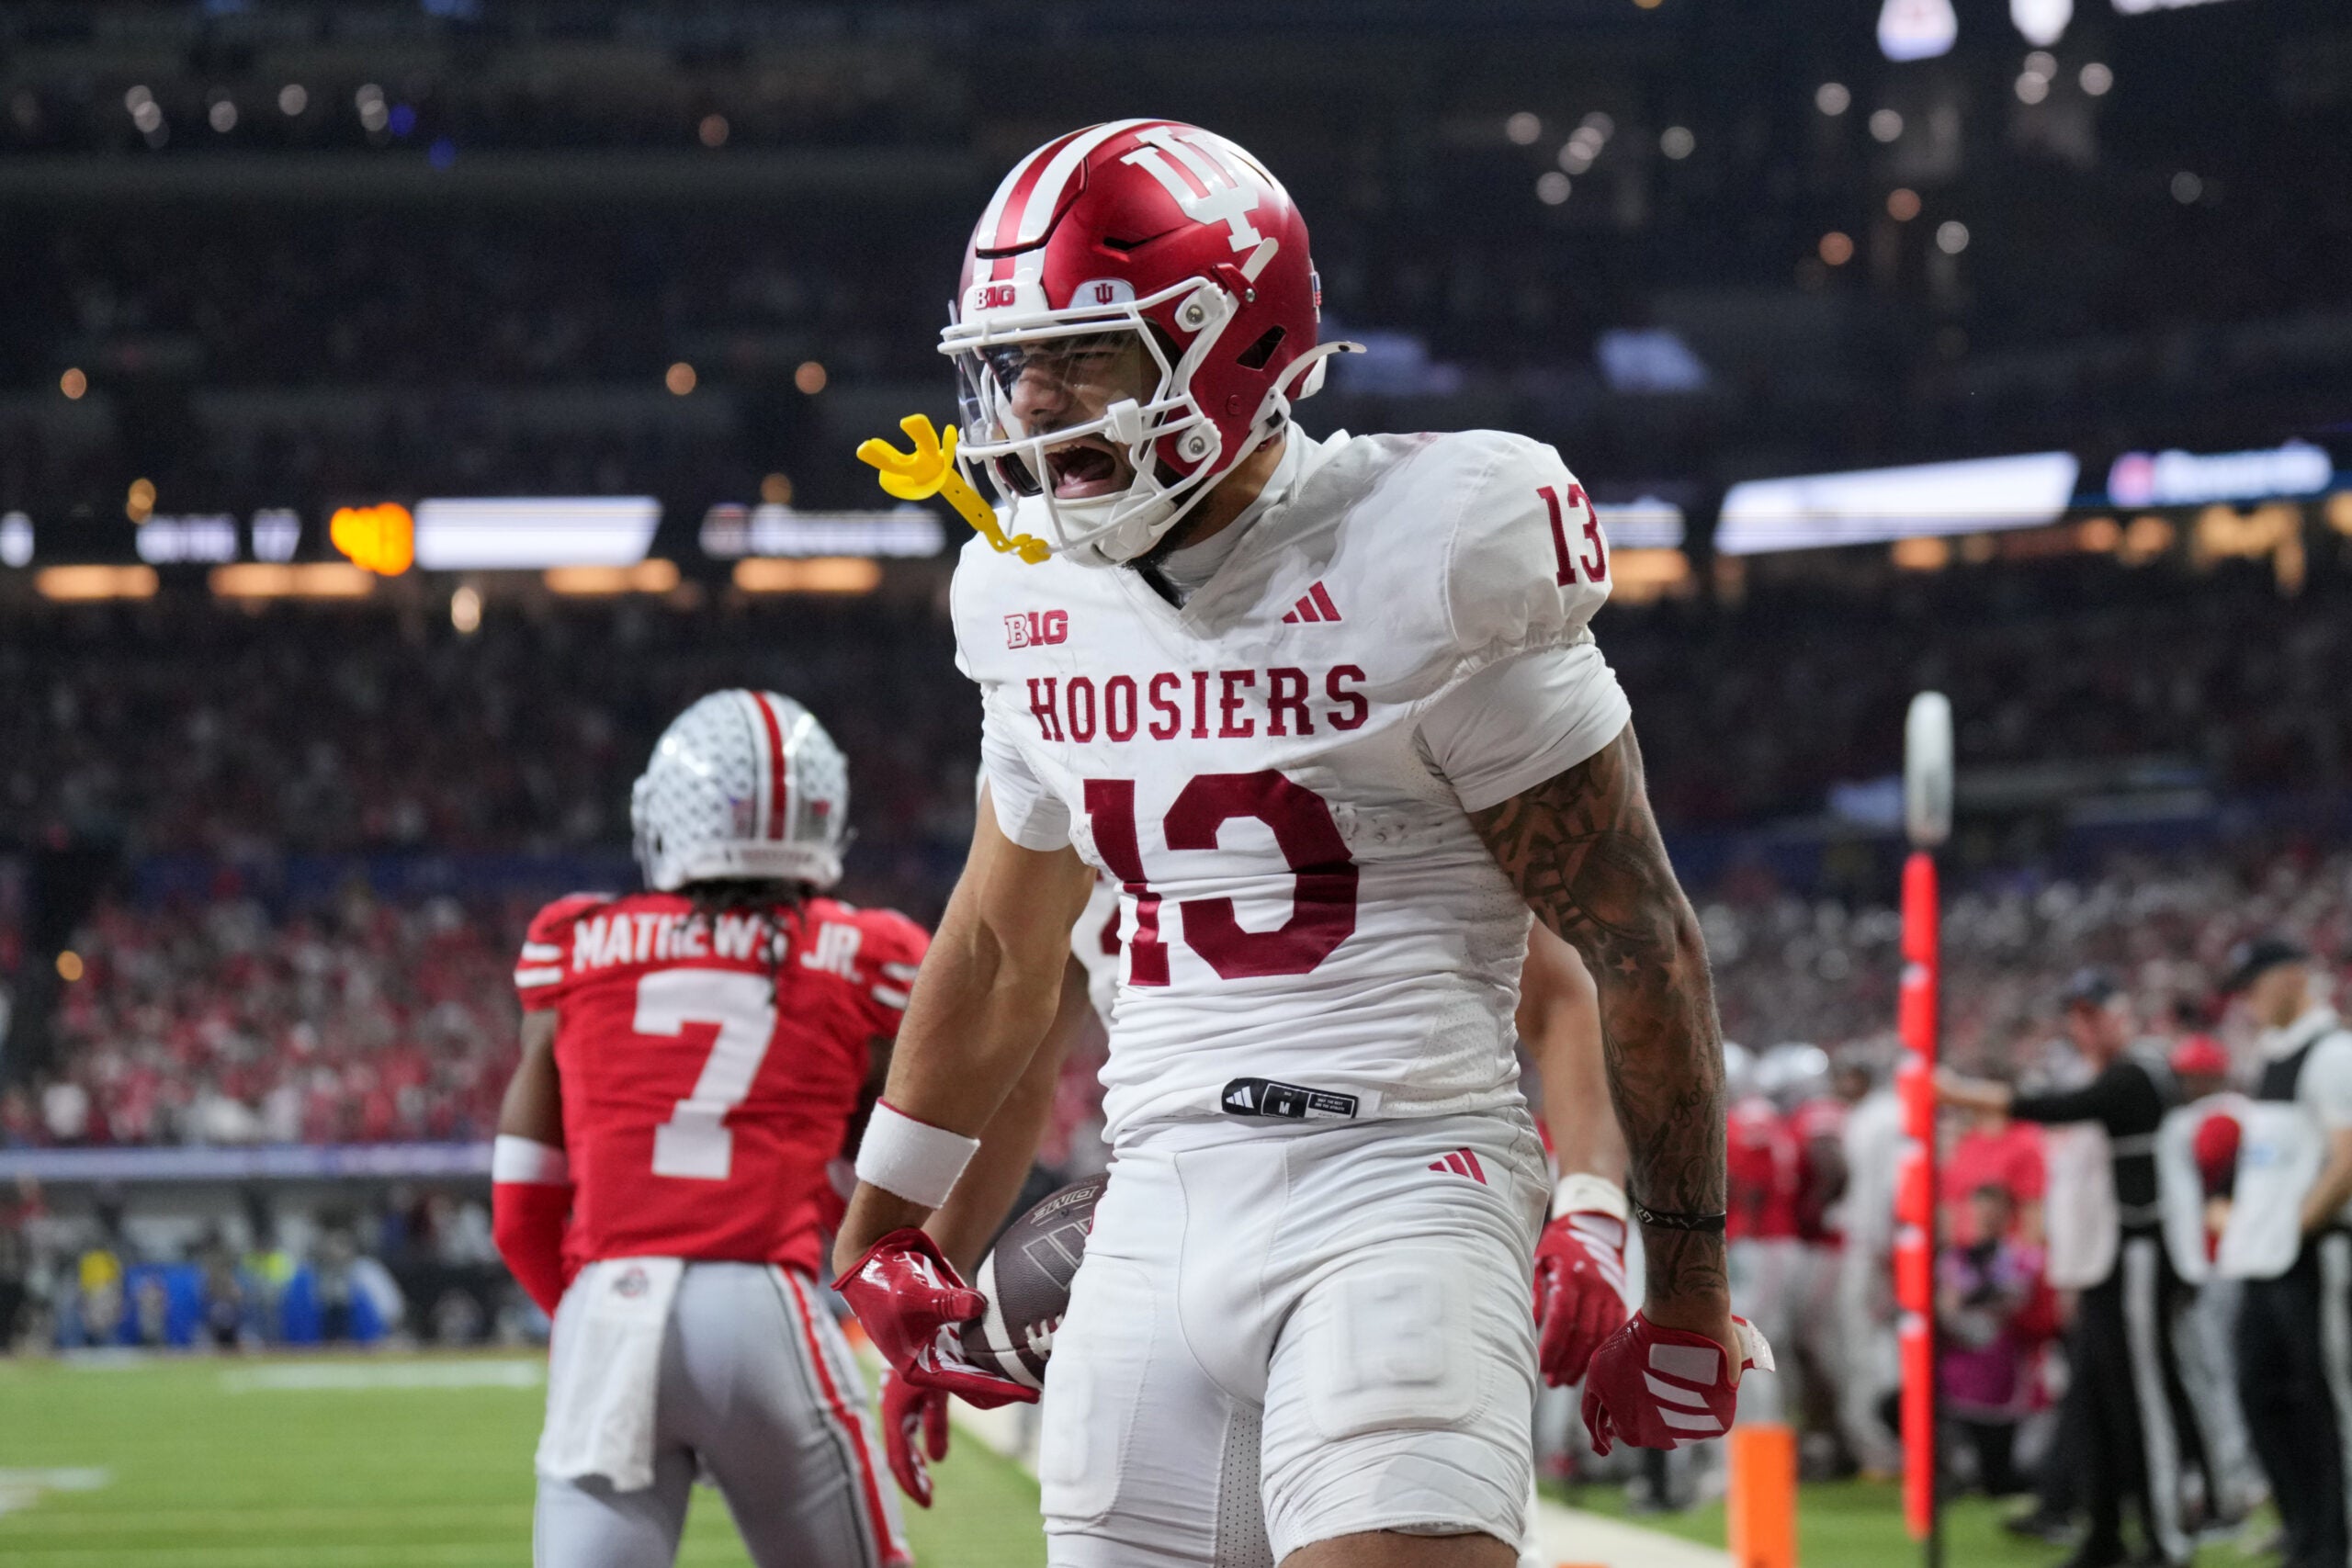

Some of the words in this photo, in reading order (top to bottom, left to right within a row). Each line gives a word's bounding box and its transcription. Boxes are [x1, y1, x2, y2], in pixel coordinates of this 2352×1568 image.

[1536, 483, 1606, 587] 13
[1026, 664, 1369, 743] HOOSIERS
[1082, 768, 1360, 987] 13
[633, 967, 777, 1180] 7
[1278, 1100, 1291, 1115] M
